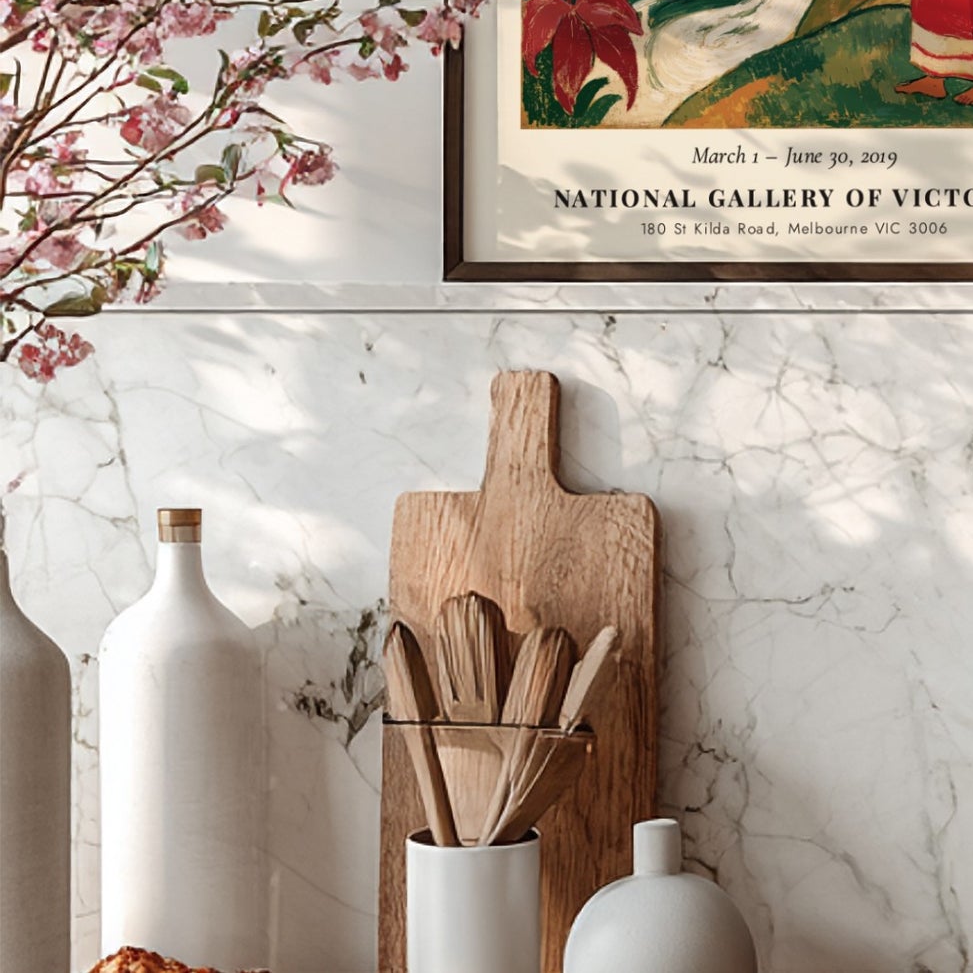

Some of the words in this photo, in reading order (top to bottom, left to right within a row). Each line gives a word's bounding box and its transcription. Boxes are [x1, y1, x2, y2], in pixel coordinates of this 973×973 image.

[692, 145, 747, 164] March
[752, 152, 759, 164] 1
[784, 146, 823, 167] June
[829, 151, 854, 170] 30,
[860, 151, 898, 169] 2019
[554, 188, 696, 208] NATIONAL
[708, 188, 834, 208] GALLERY
[846, 188, 882, 207] OF
[640, 222, 666, 236] 180
[674, 222, 687, 236] St
[694, 221, 730, 235] Kilda
[738, 221, 779, 237] Road,
[788, 221, 868, 235] Melbourne
[875, 221, 900, 235] VIC
[908, 221, 948, 235] 3006
